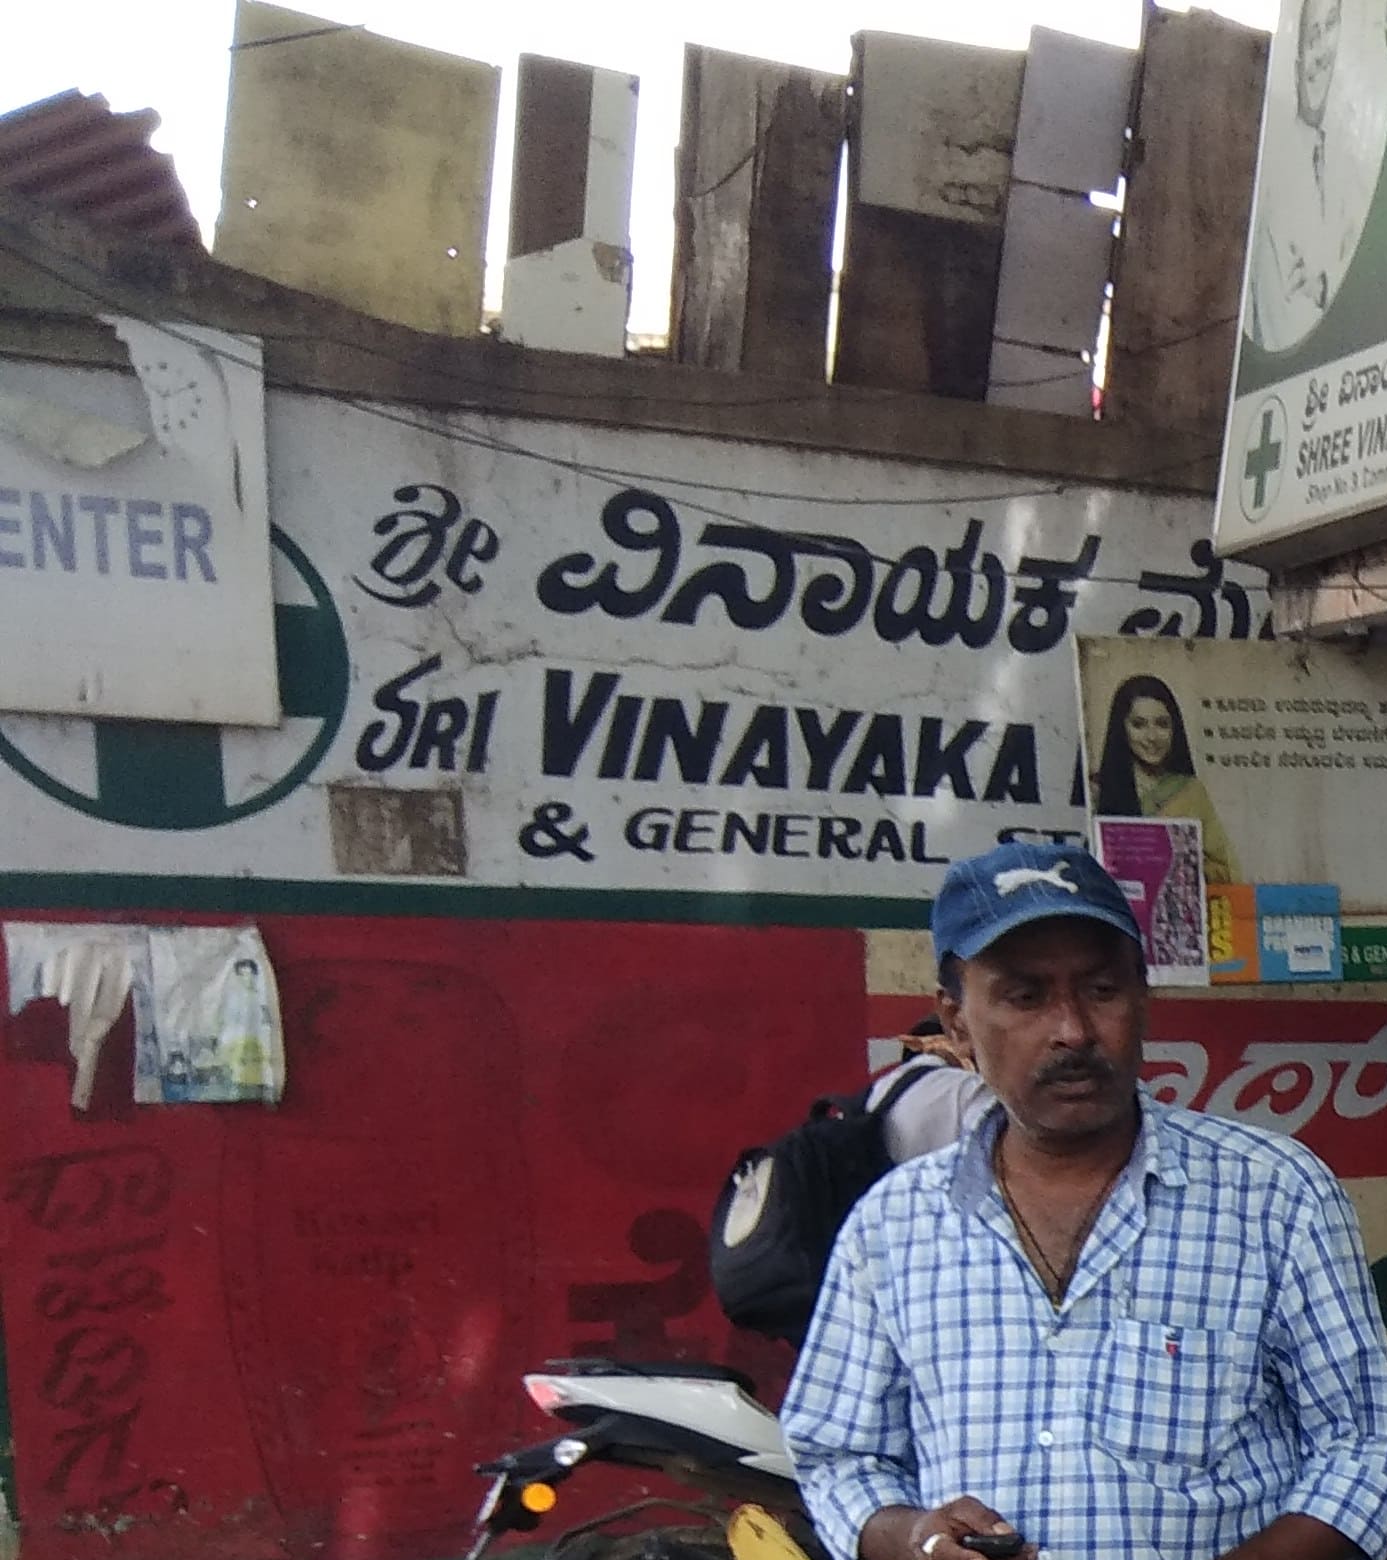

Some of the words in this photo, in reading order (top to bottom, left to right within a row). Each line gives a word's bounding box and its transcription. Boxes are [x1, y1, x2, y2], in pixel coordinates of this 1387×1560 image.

[1296, 427, 1353, 479] SHREE
[353, 484, 499, 606] ಶ್ರೀ
[537, 488, 1101, 654] ವಿನಾಯಕ
[356, 654, 499, 772] SRI
[541, 668, 1046, 807] VINAYAKA
[519, 803, 594, 861] &
[624, 807, 951, 865] GENERAL
